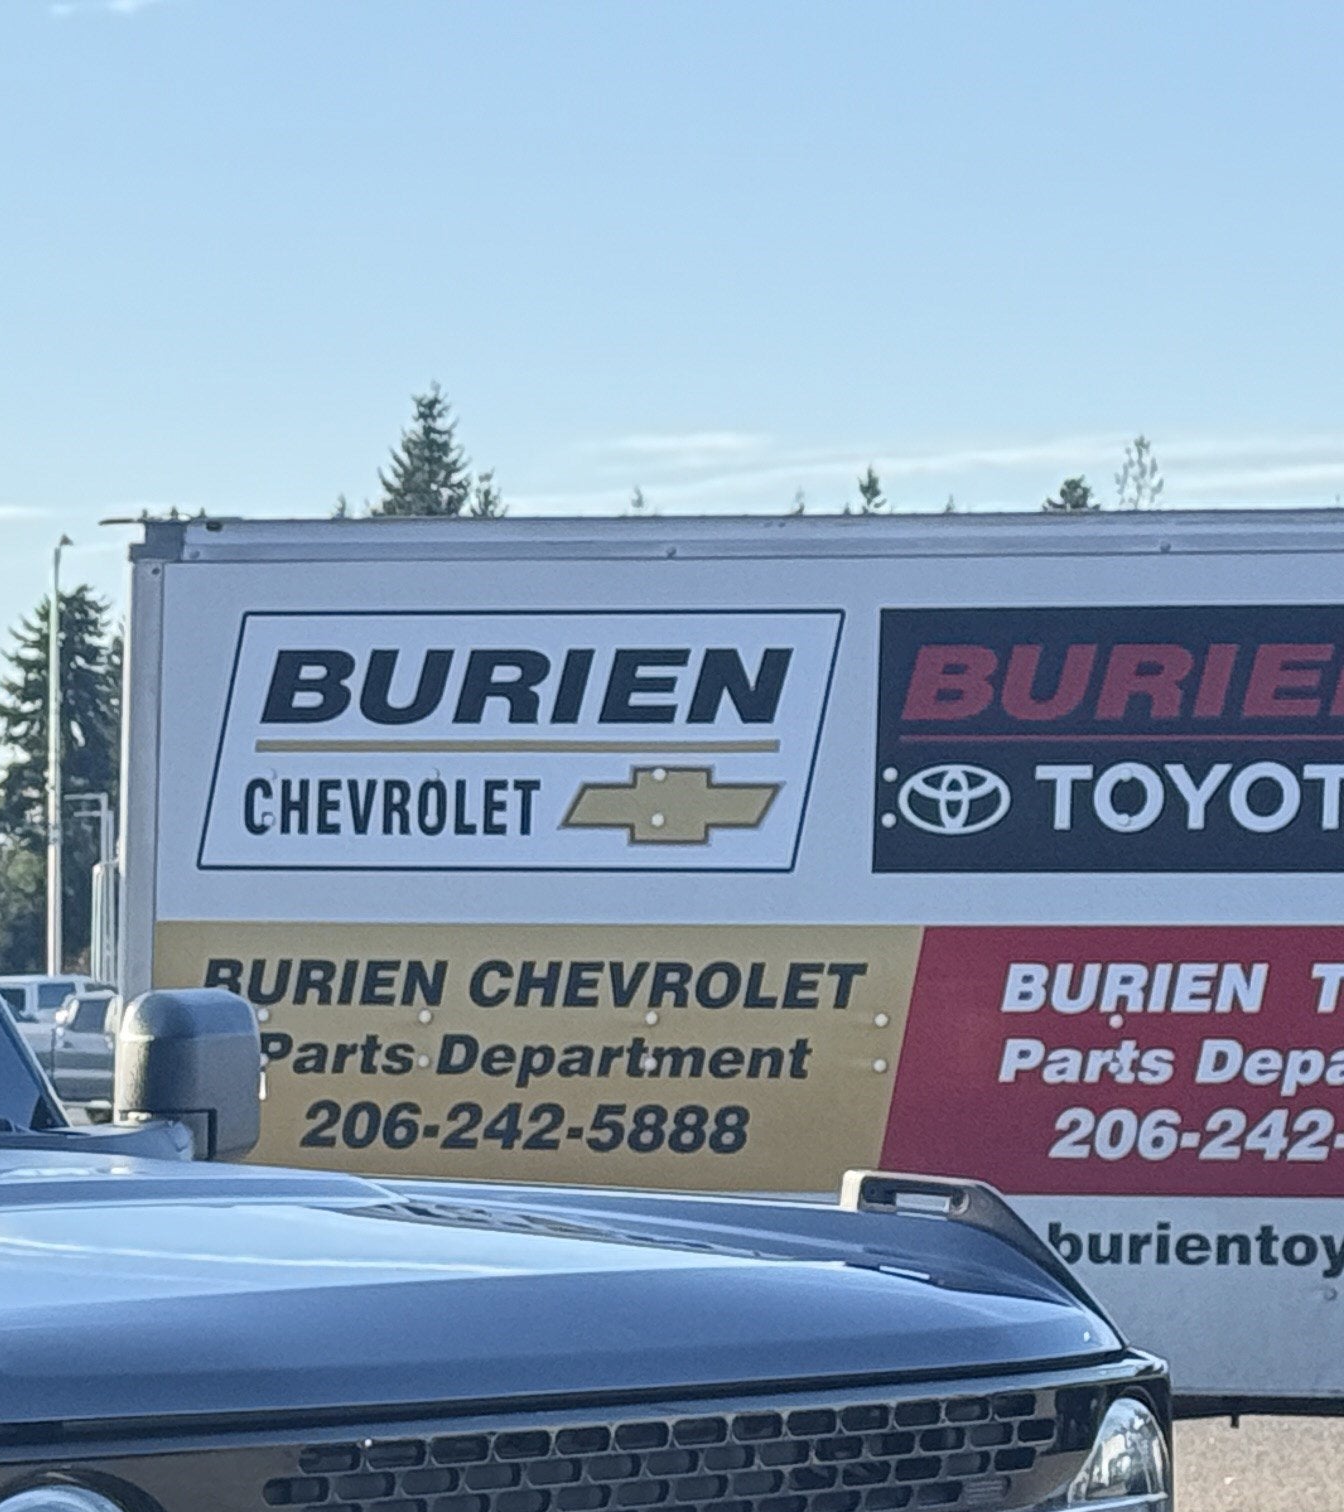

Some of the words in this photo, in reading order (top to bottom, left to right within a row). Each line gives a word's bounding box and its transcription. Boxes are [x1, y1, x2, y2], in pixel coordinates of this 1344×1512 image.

[258, 648, 794, 725] BURIEN
[900, 643, 1344, 721] BURIE
[243, 777, 542, 836] CHEVROLET
[1034, 761, 1344, 833] TOYOT
[204, 957, 449, 1008] BURIEN
[469, 959, 868, 1010] CHEVROLET
[1000, 962, 1270, 1015] BURIEN
[259, 1031, 415, 1076] Parts
[436, 1034, 813, 1088] Department
[998, 1038, 1176, 1085] Parts
[298, 1099, 751, 1154] 206-242-5888
